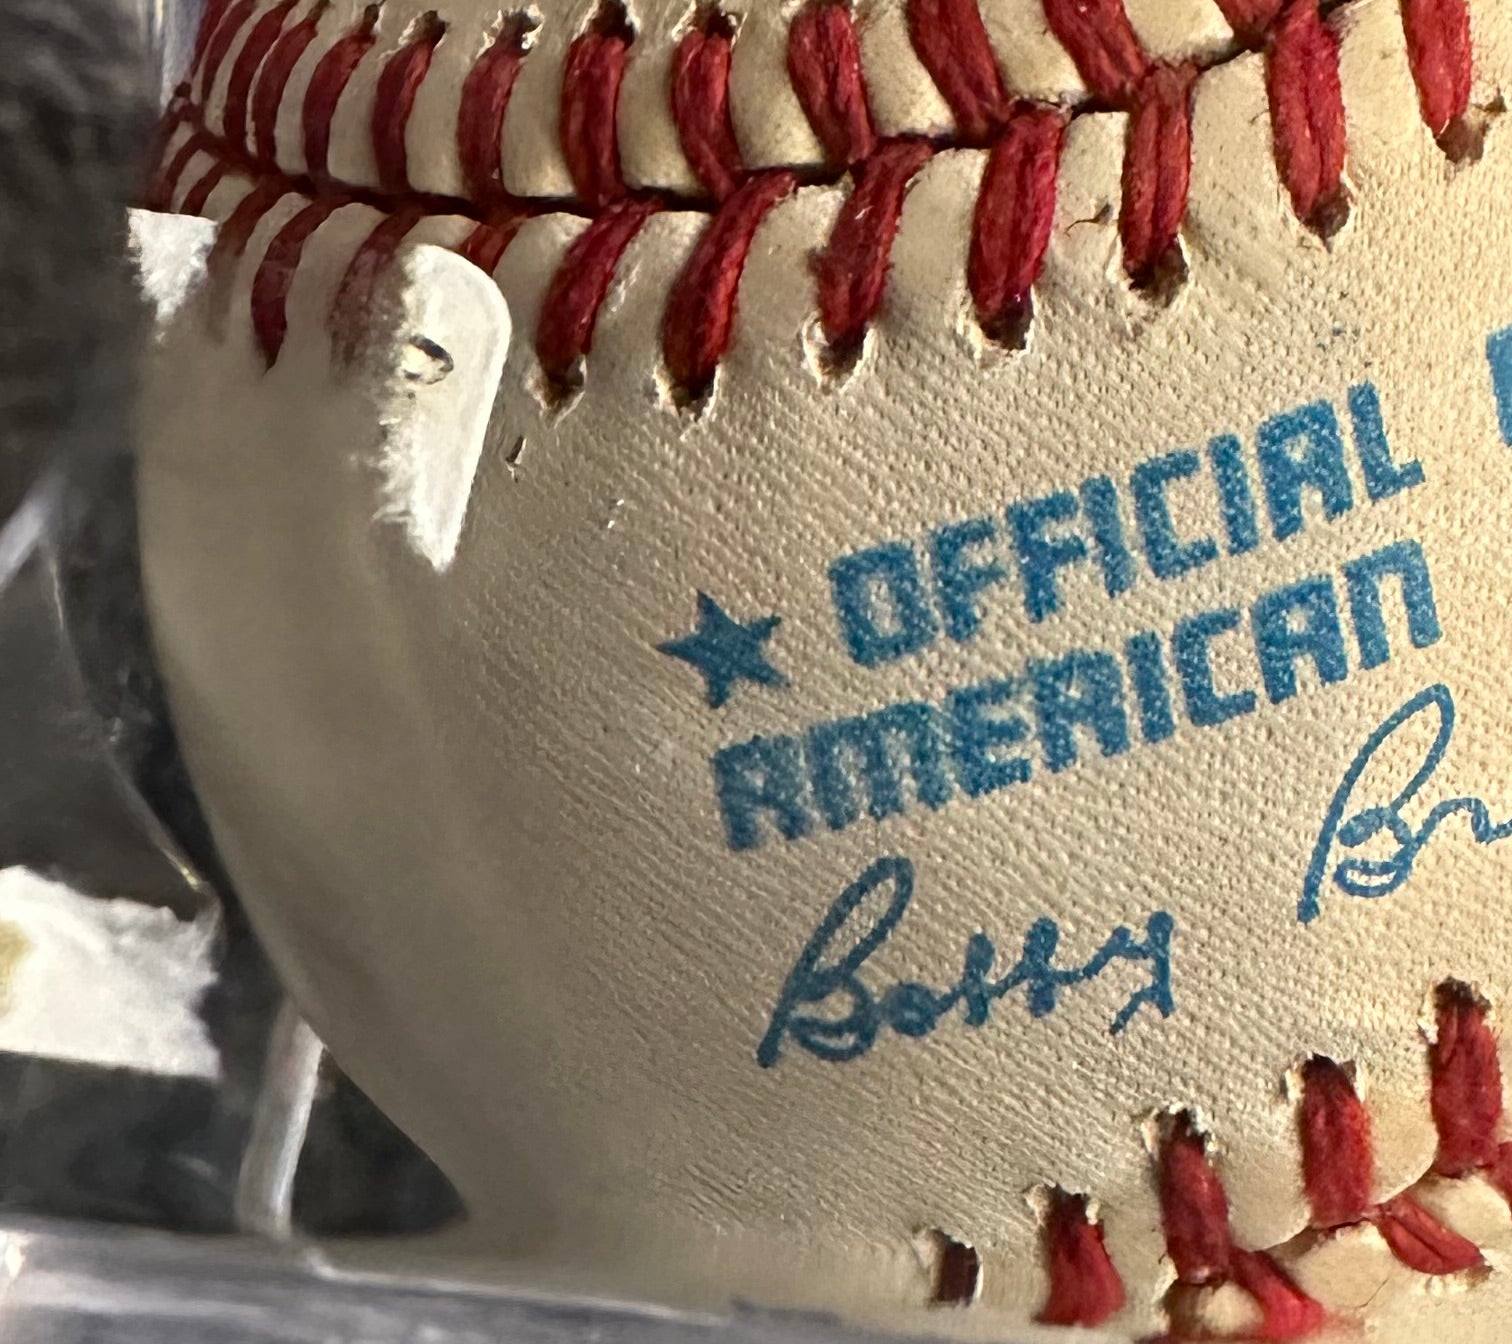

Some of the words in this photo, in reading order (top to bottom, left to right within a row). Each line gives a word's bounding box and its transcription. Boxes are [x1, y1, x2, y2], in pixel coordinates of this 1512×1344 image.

[827, 381, 1426, 669] OFFICIAL
[711, 540, 1442, 851] AMERICAN
[756, 856, 1176, 1068] Bobby
